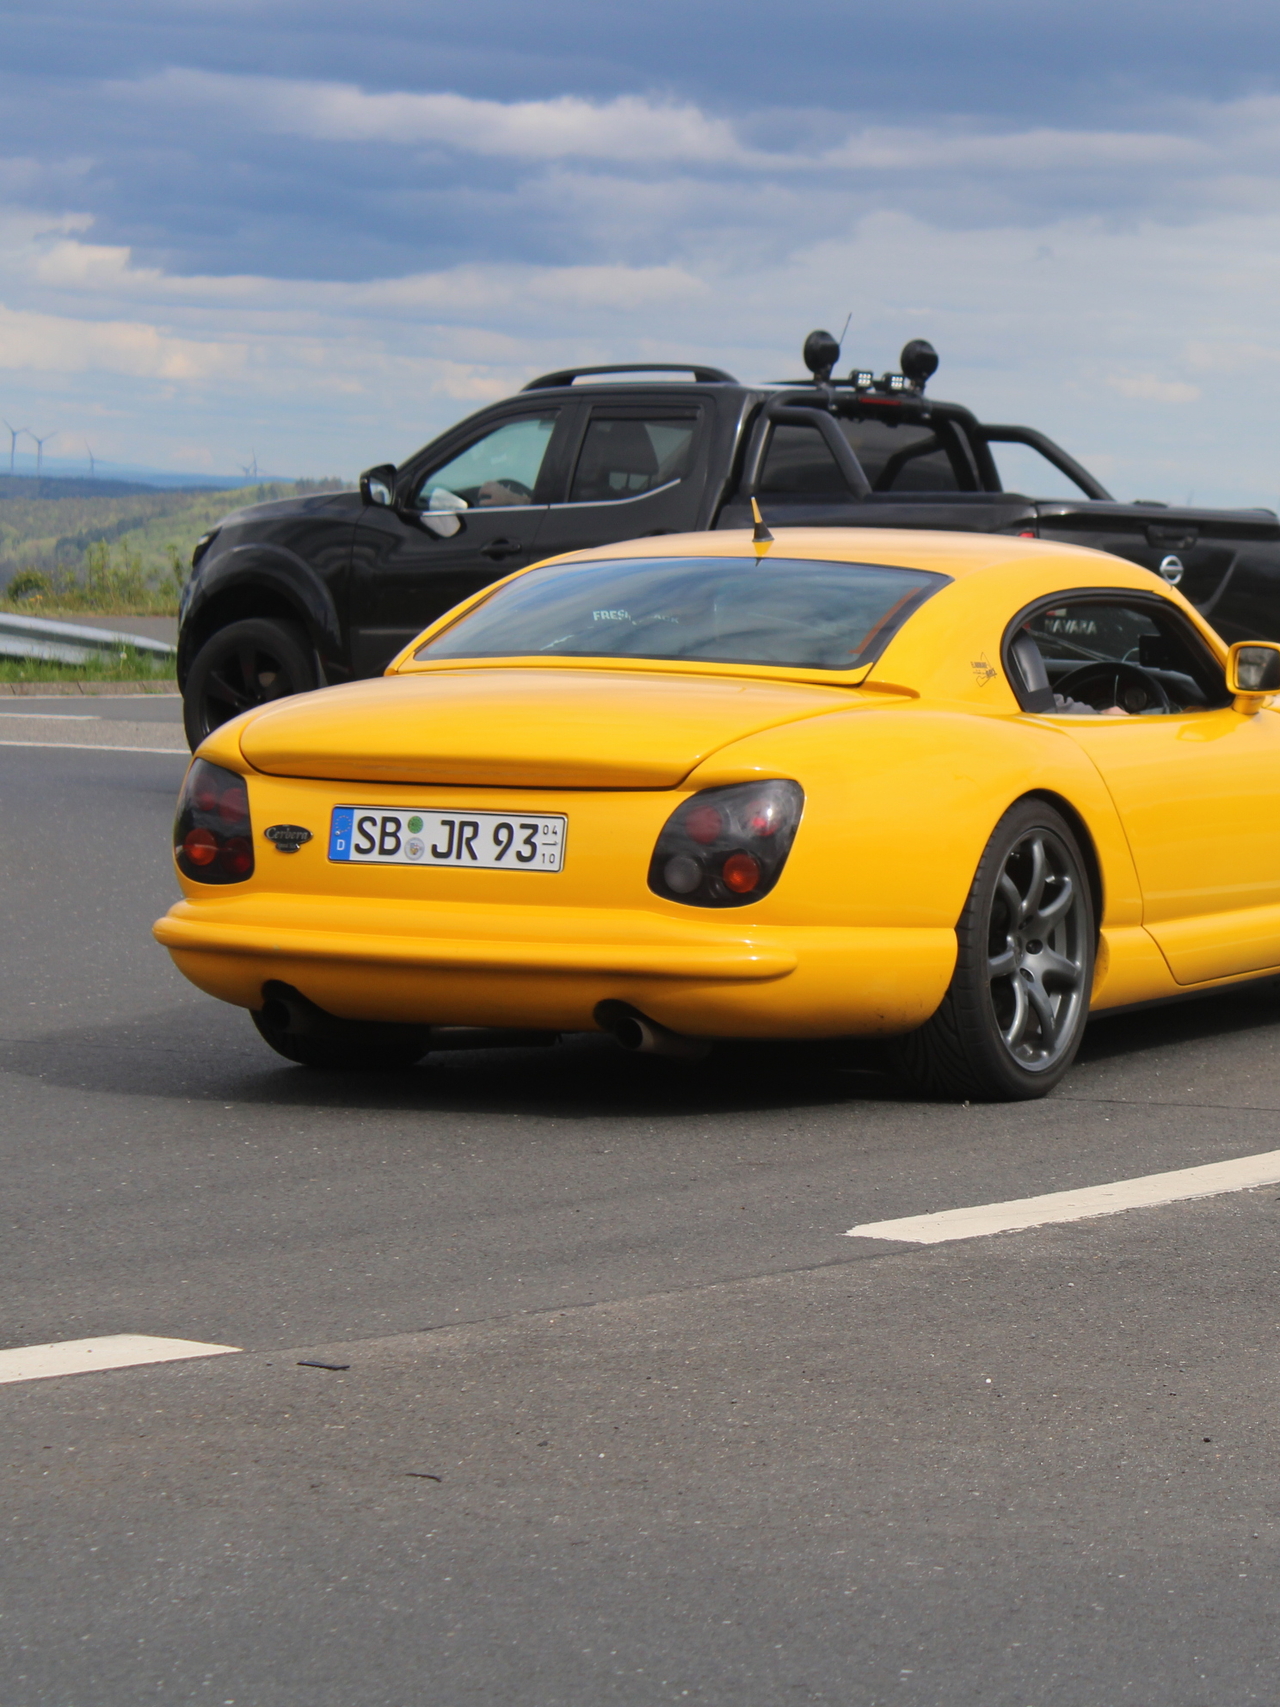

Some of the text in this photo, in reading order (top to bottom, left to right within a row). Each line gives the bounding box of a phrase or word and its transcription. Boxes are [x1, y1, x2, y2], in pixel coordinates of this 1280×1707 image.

[1044, 618, 1097, 634] NAVARA
[265, 827, 308, 840] Cerbera
[542, 825, 558, 836] 04
[336, 839, 346, 851] D
[354, 815, 539, 863] SB JR 93
[541, 853, 556, 864] 10
